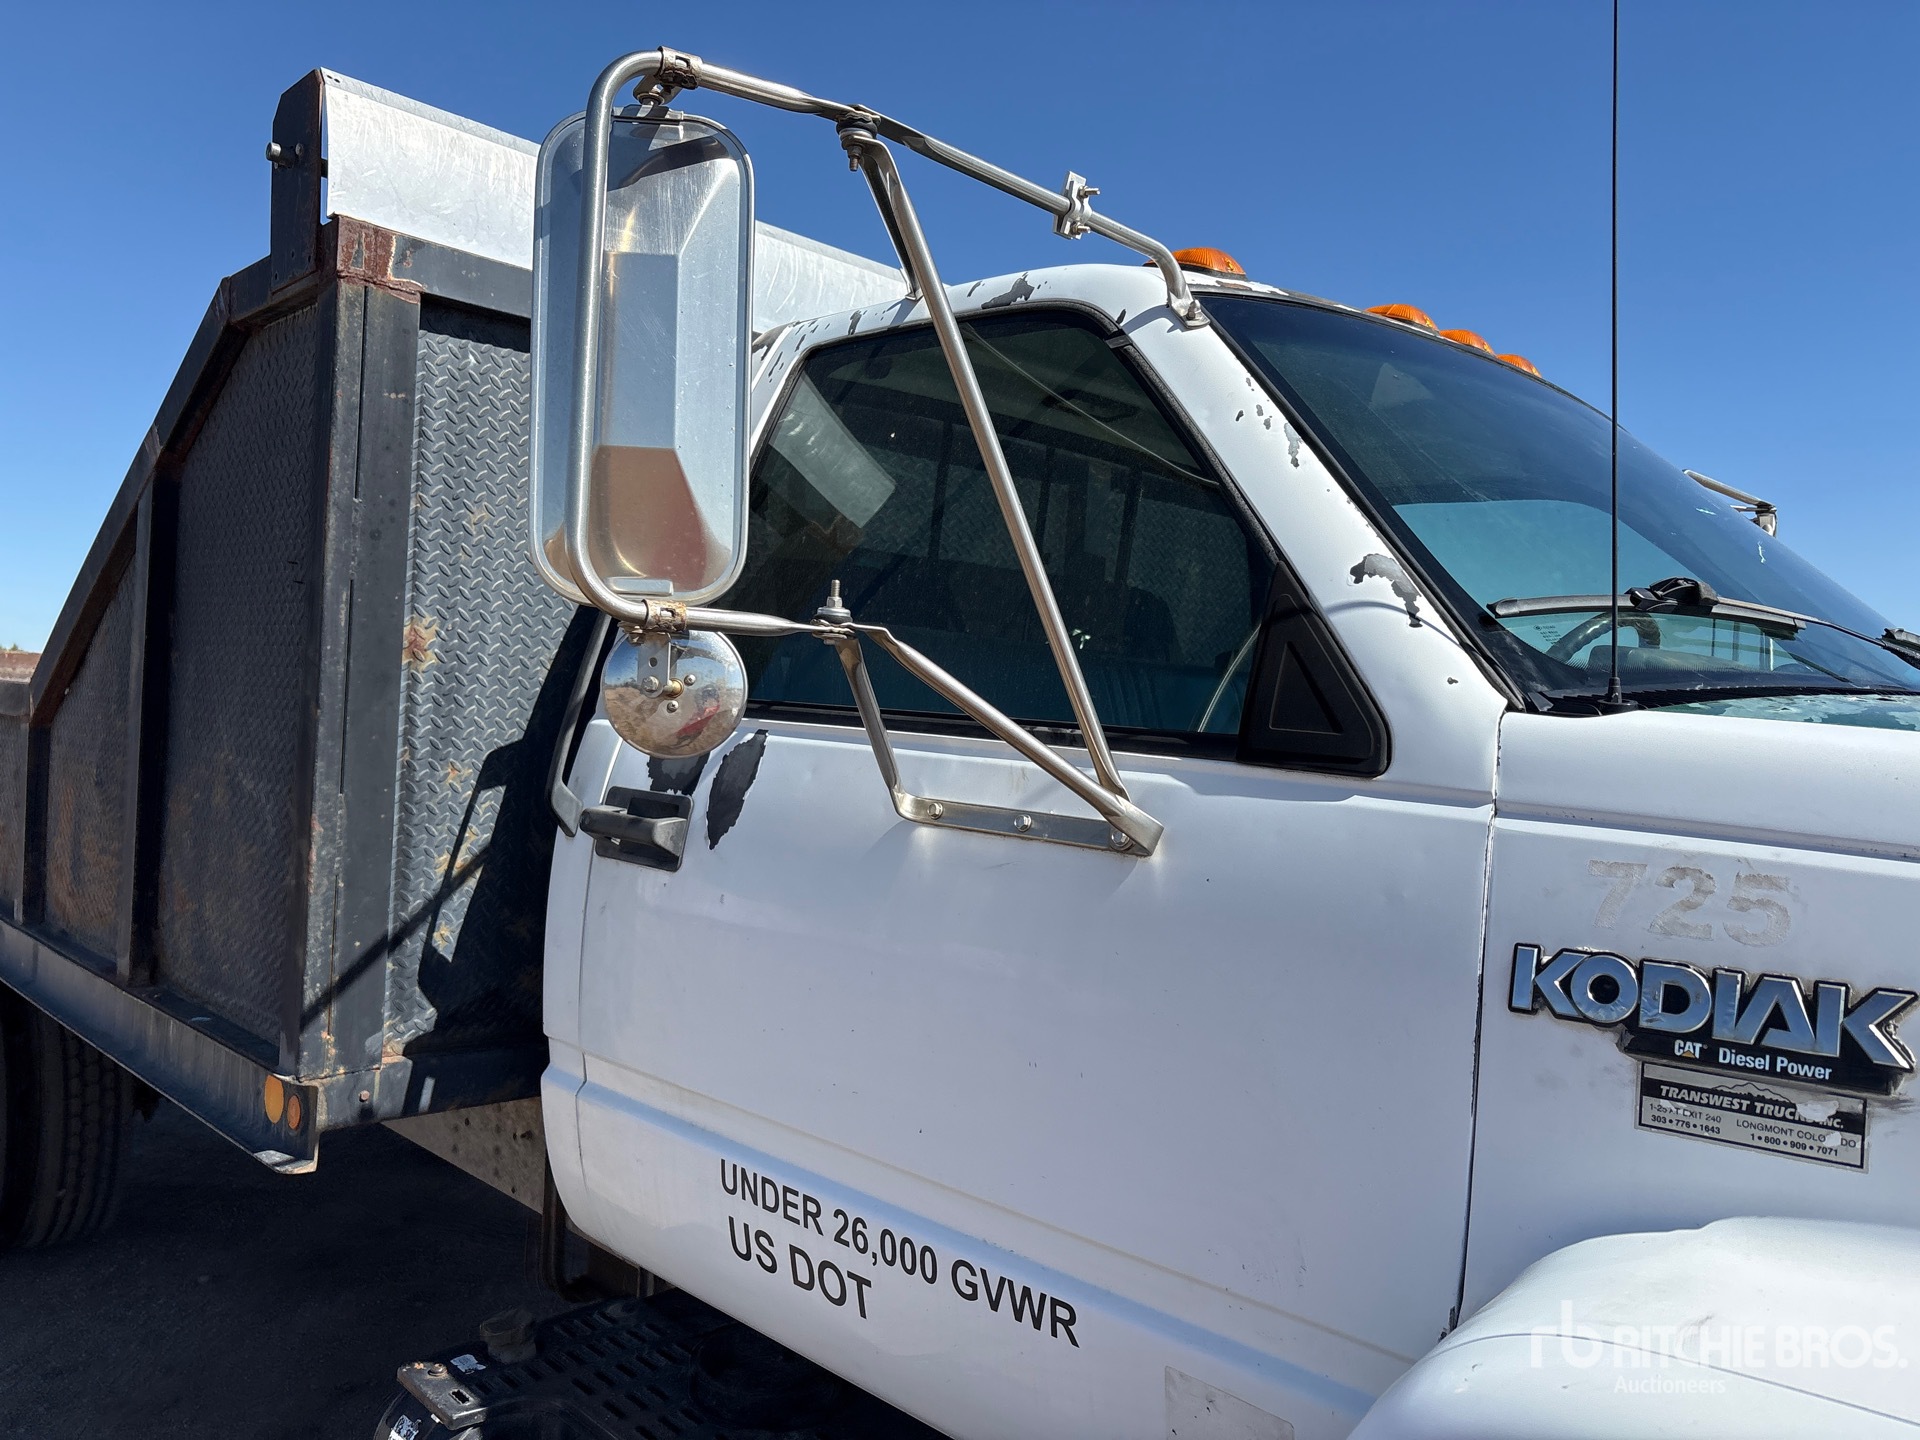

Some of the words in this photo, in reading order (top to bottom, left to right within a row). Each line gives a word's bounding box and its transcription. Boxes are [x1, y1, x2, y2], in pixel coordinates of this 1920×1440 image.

[1587, 859, 1792, 948] 725
[1508, 942, 1919, 1074] KODIAK
[1674, 1039, 1702, 1059] CAT
[1718, 1047, 1770, 1071] Diesel
[1776, 1056, 1833, 1080] Power
[1660, 1085, 1750, 1111] TRANSWEST
[1705, 1113, 1722, 1123] 240
[1736, 1119, 1794, 1137] LONGMONT
[1796, 1130, 1857, 1148] COLODO
[720, 1158, 824, 1236] UNDER
[833, 1208, 938, 1285] 26,000
[950, 1259, 1080, 1348] GVWR
[728, 1215, 779, 1274] US
[788, 1243, 872, 1320] DOT
